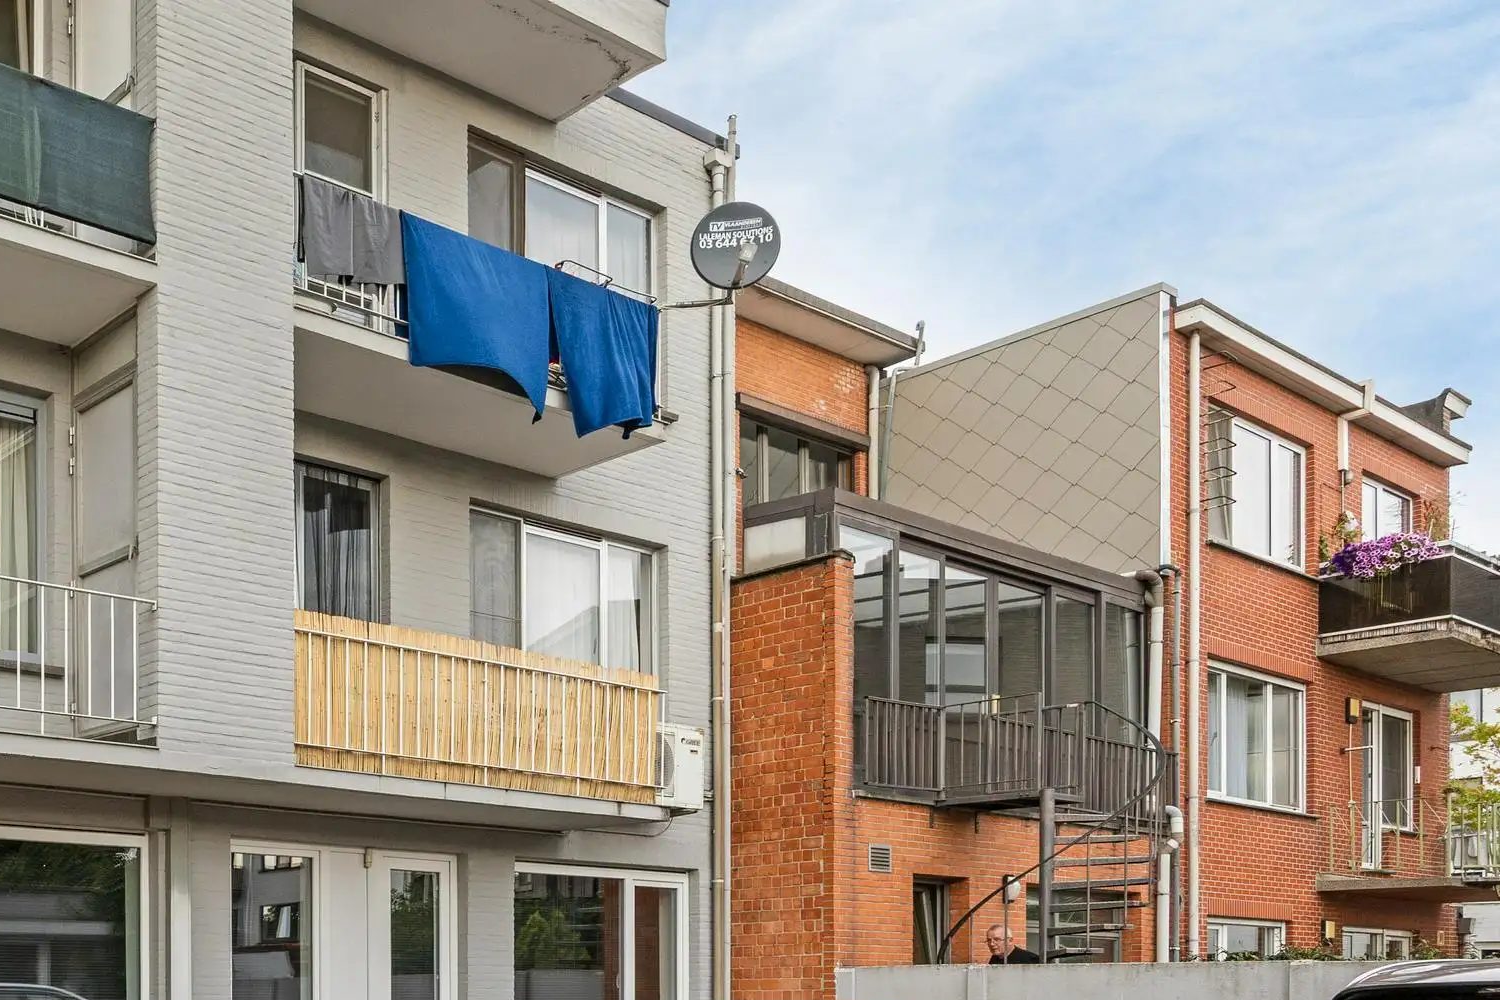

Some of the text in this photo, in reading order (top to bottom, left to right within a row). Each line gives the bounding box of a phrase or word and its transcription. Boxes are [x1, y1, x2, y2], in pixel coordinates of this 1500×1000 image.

[699, 232, 731, 240] LALEMAN
[732, 226, 773, 238] SOLUTIONS
[710, 222, 724, 231] TV
[699, 239, 713, 248] 03
[715, 238, 737, 248] 644
[758, 233, 773, 243] 10
